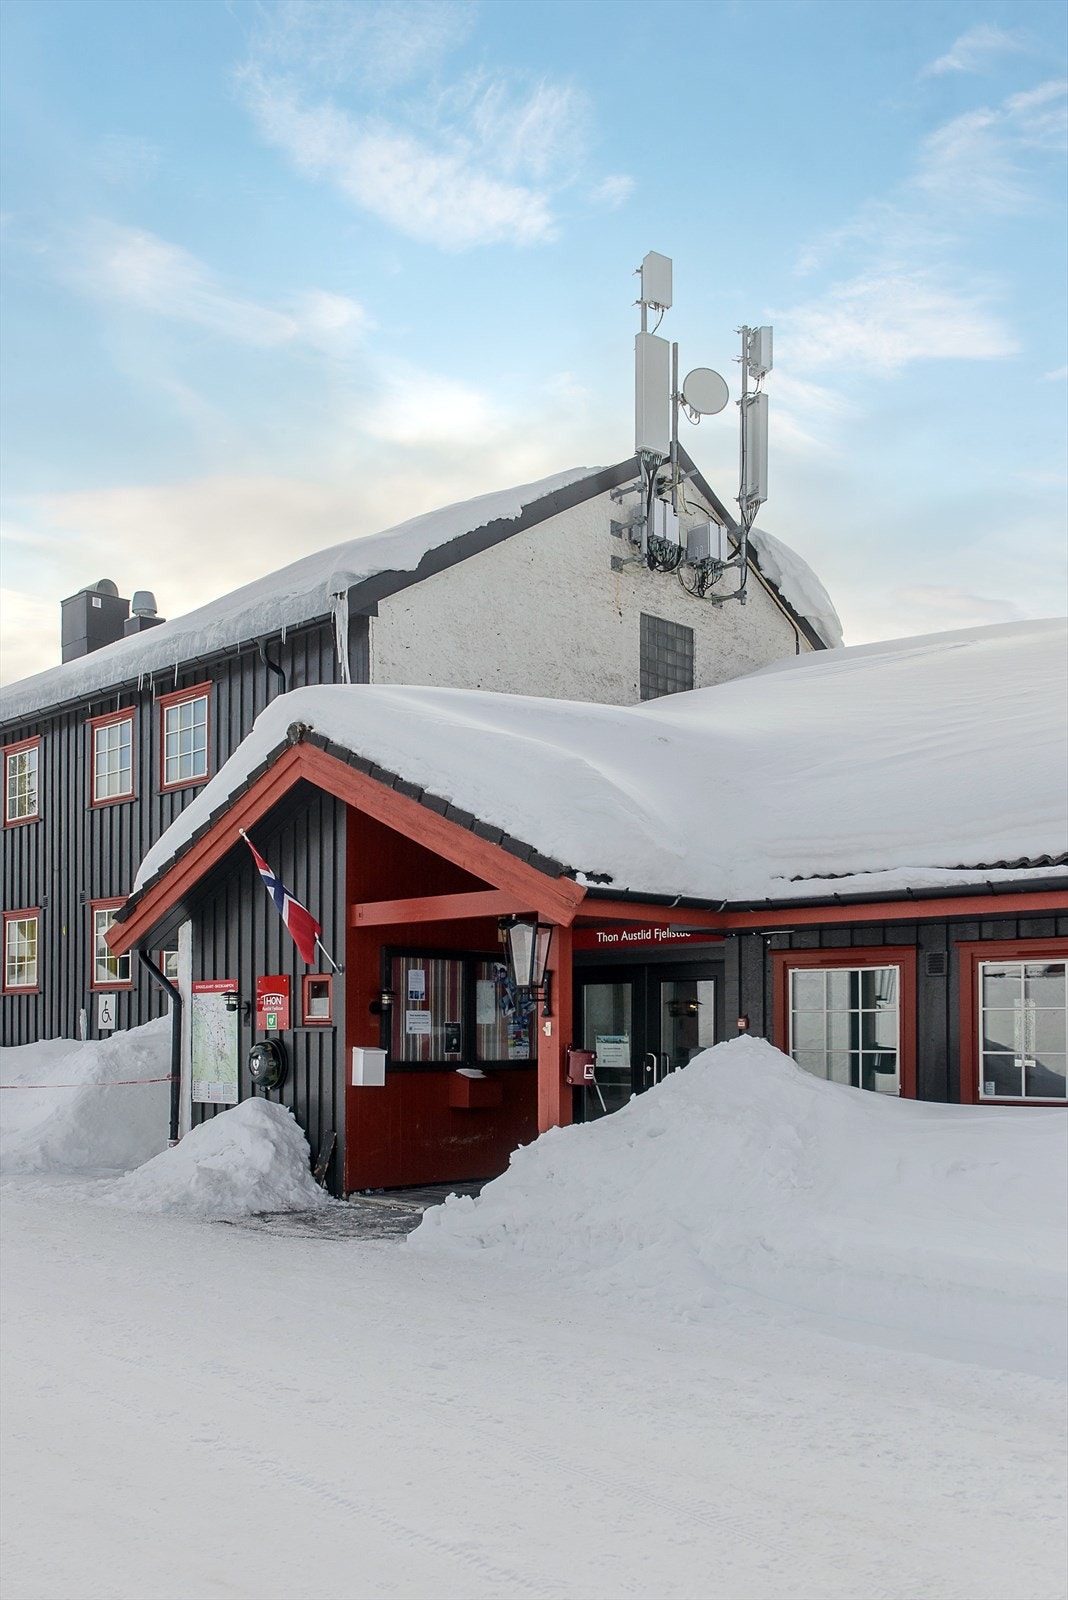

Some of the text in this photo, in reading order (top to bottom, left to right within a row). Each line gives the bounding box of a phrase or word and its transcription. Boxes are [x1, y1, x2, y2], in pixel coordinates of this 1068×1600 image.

[596, 932, 618, 942] Thon
[621, 930, 651, 941] Austlid
[261, 993, 285, 1005] THON
